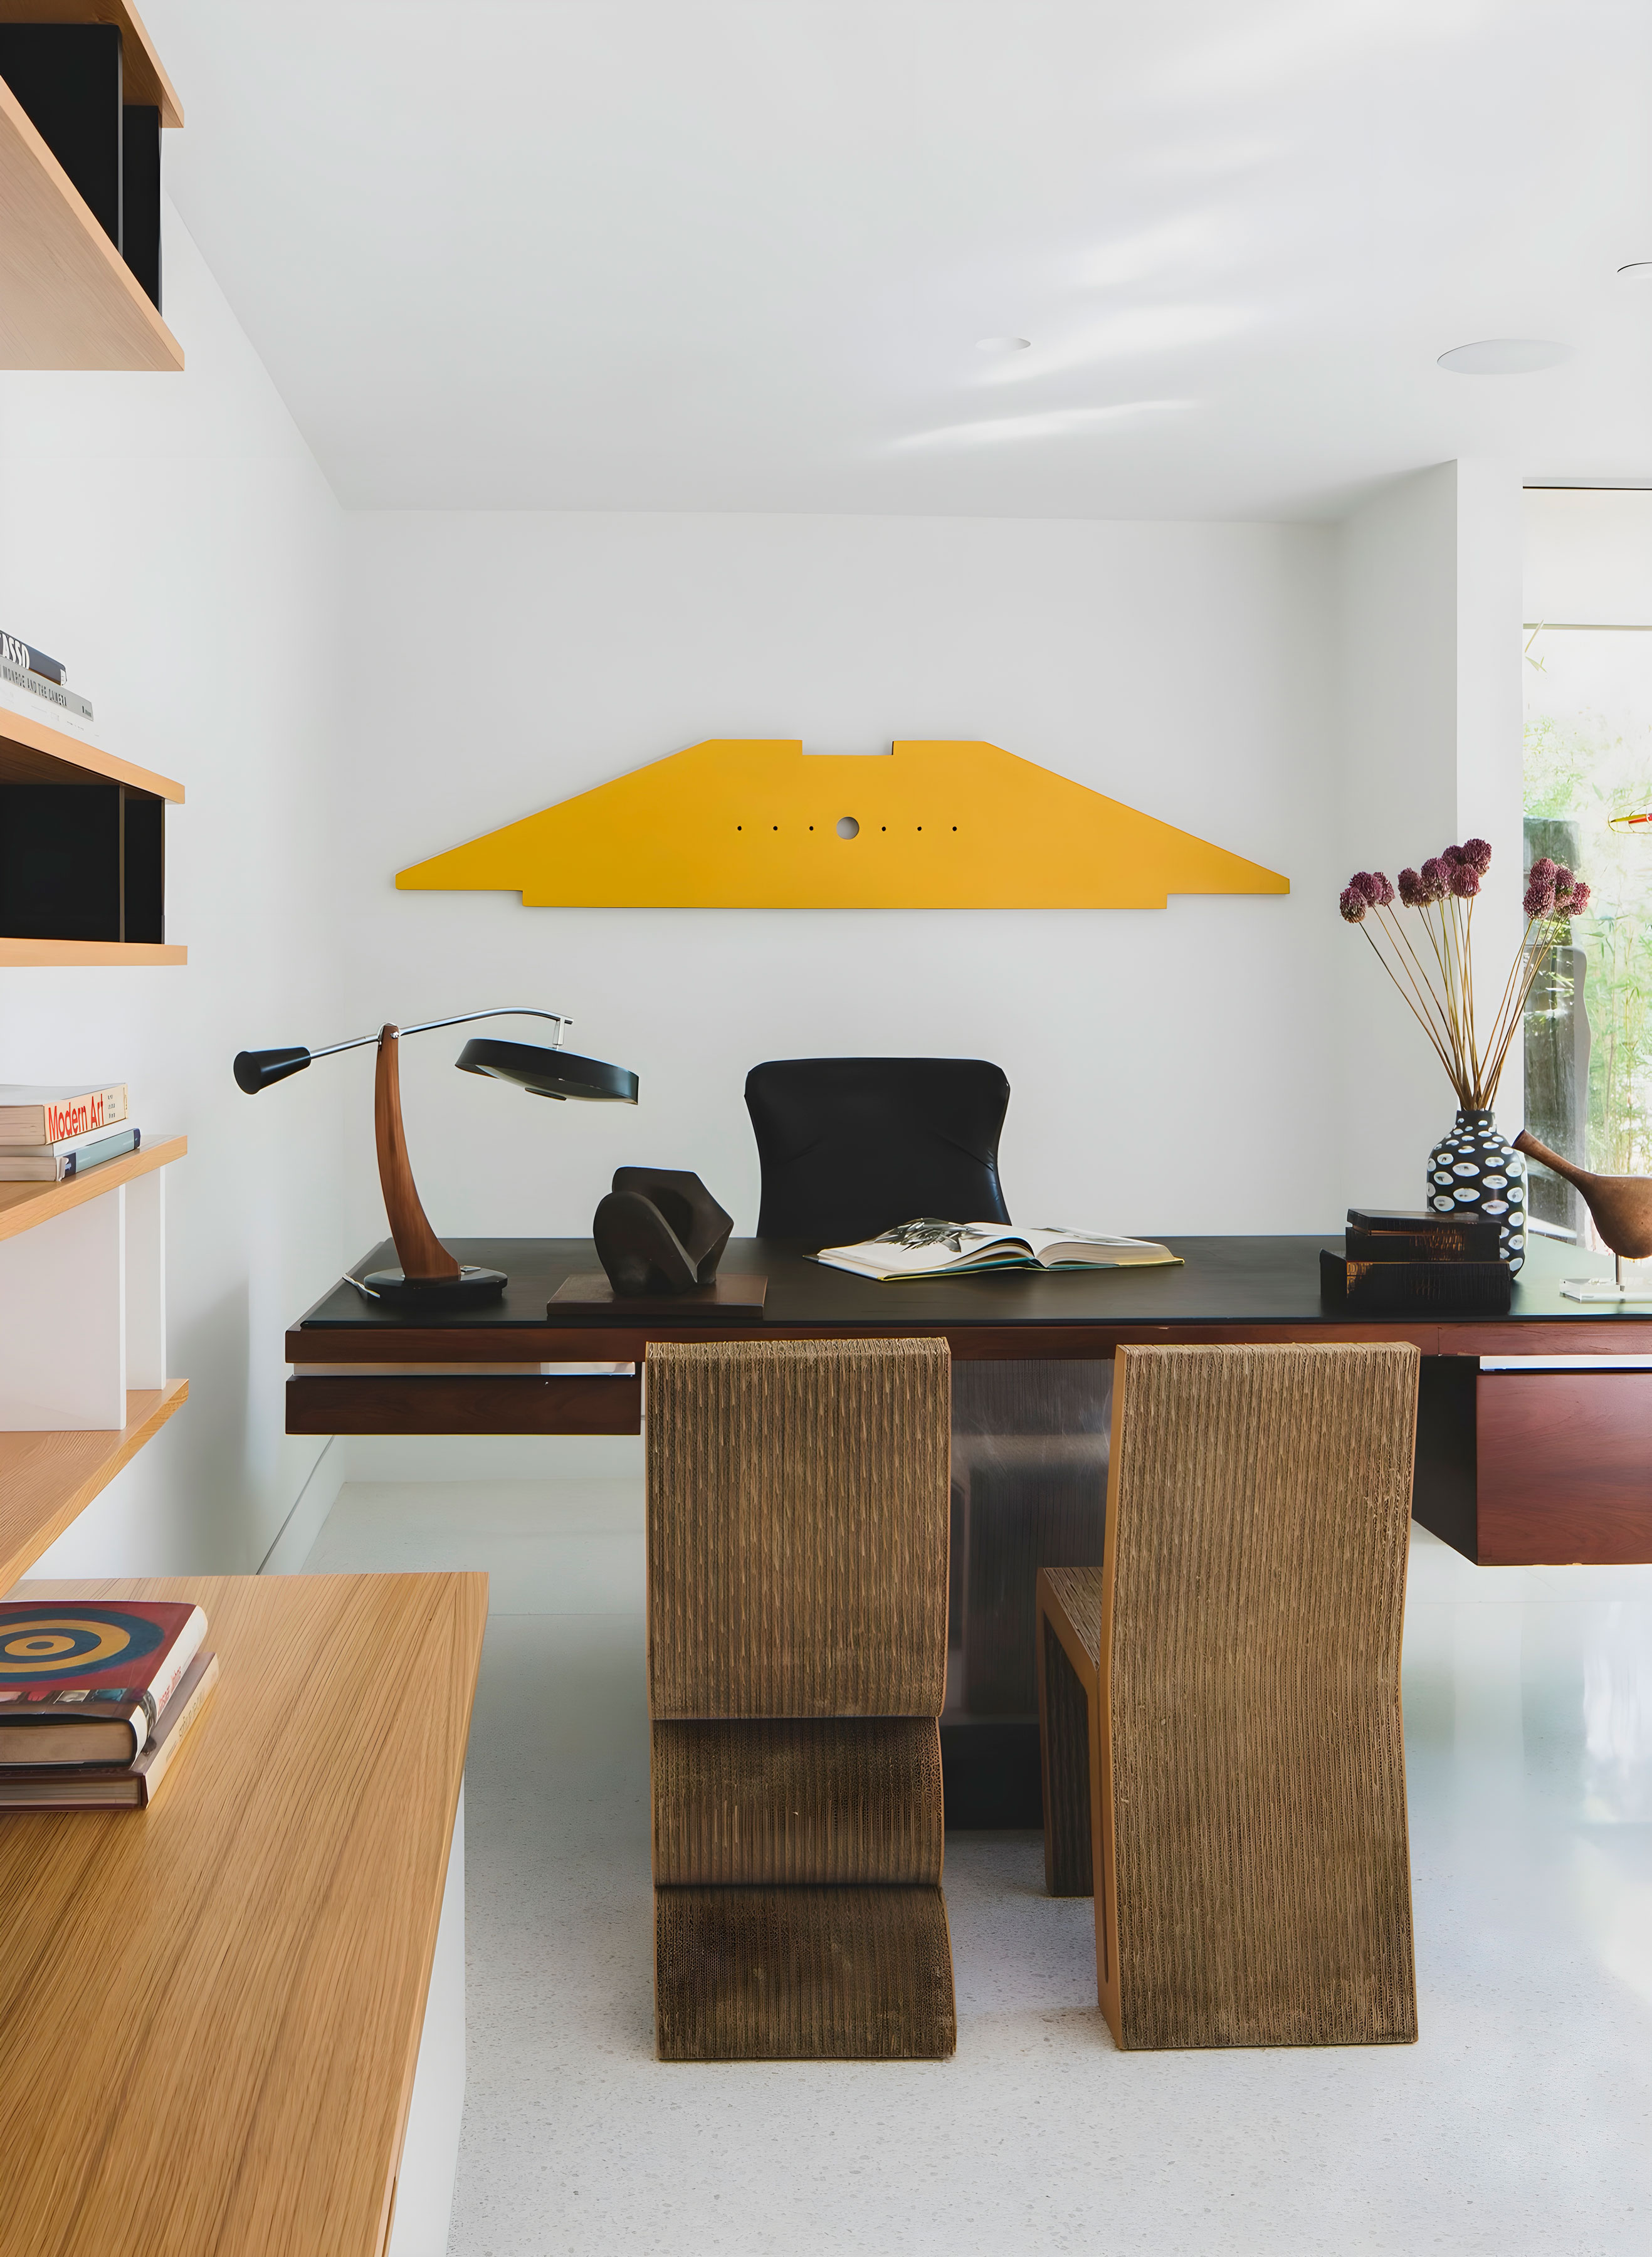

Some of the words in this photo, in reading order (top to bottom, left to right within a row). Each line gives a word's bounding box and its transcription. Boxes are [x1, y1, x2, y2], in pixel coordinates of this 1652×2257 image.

[0, 633, 30, 670] ASSO
[48, 1102, 88, 1142] Modern
[90, 1093, 104, 1129] Art
